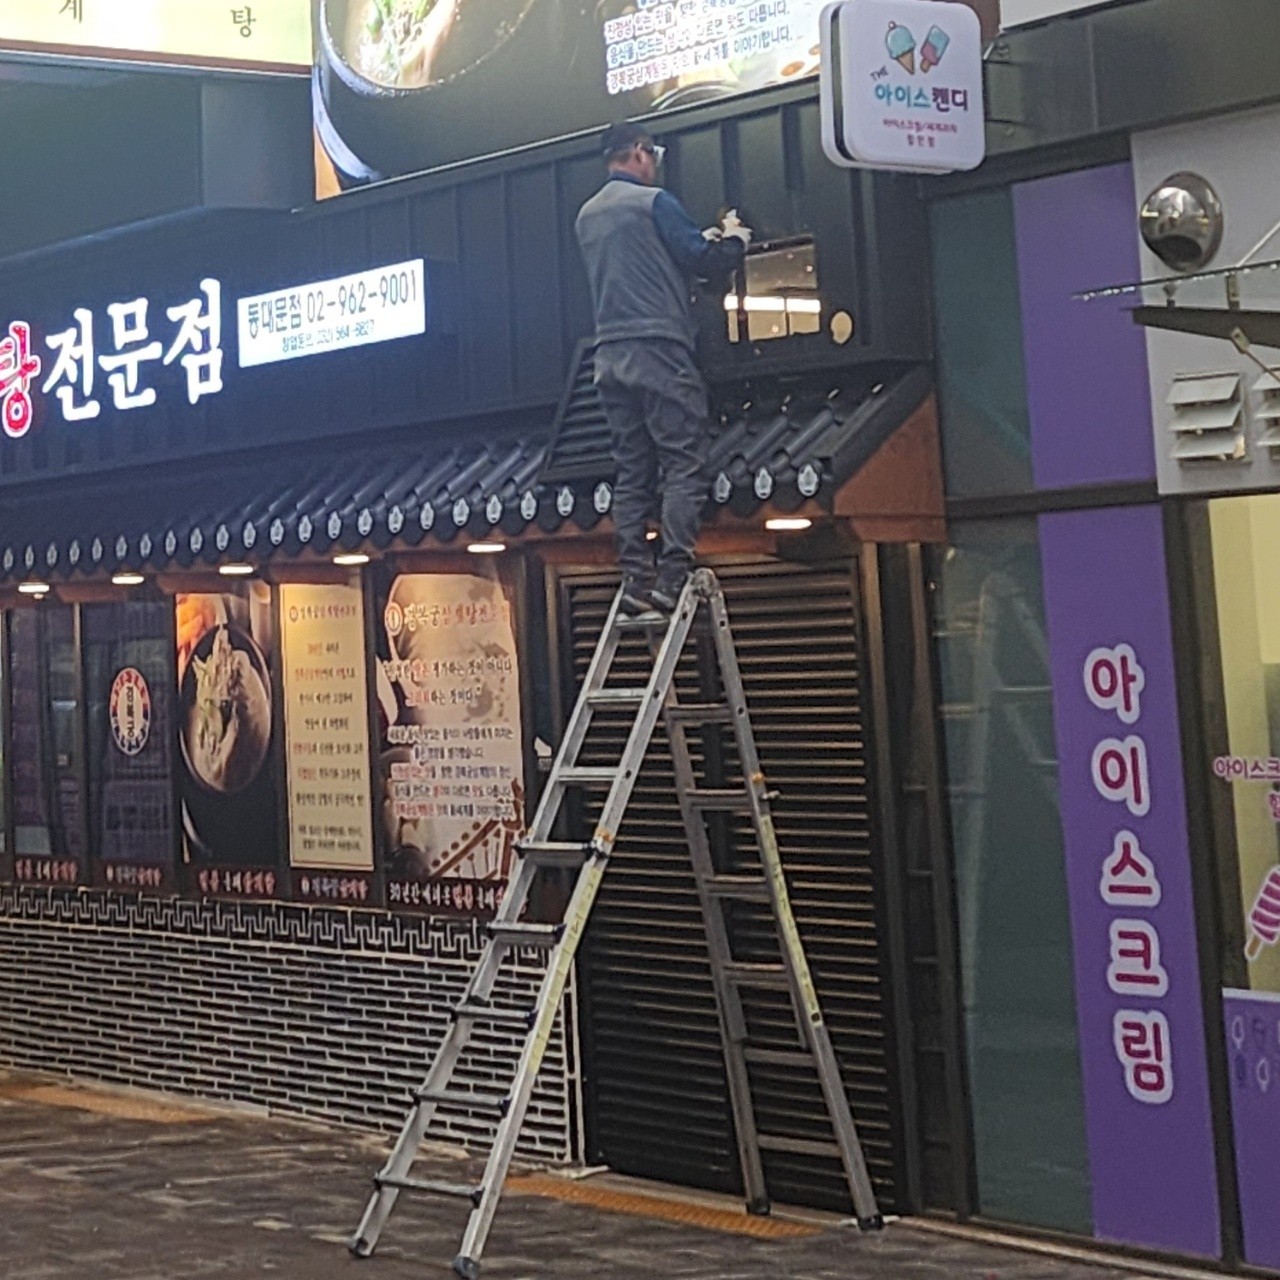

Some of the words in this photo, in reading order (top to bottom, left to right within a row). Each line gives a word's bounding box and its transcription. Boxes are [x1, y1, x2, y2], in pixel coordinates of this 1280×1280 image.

[248, 293, 302, 340] 동대문점
[307, 269, 417, 324] 02-962-9001
[1088, 649, 1168, 1097] 아이스크림
